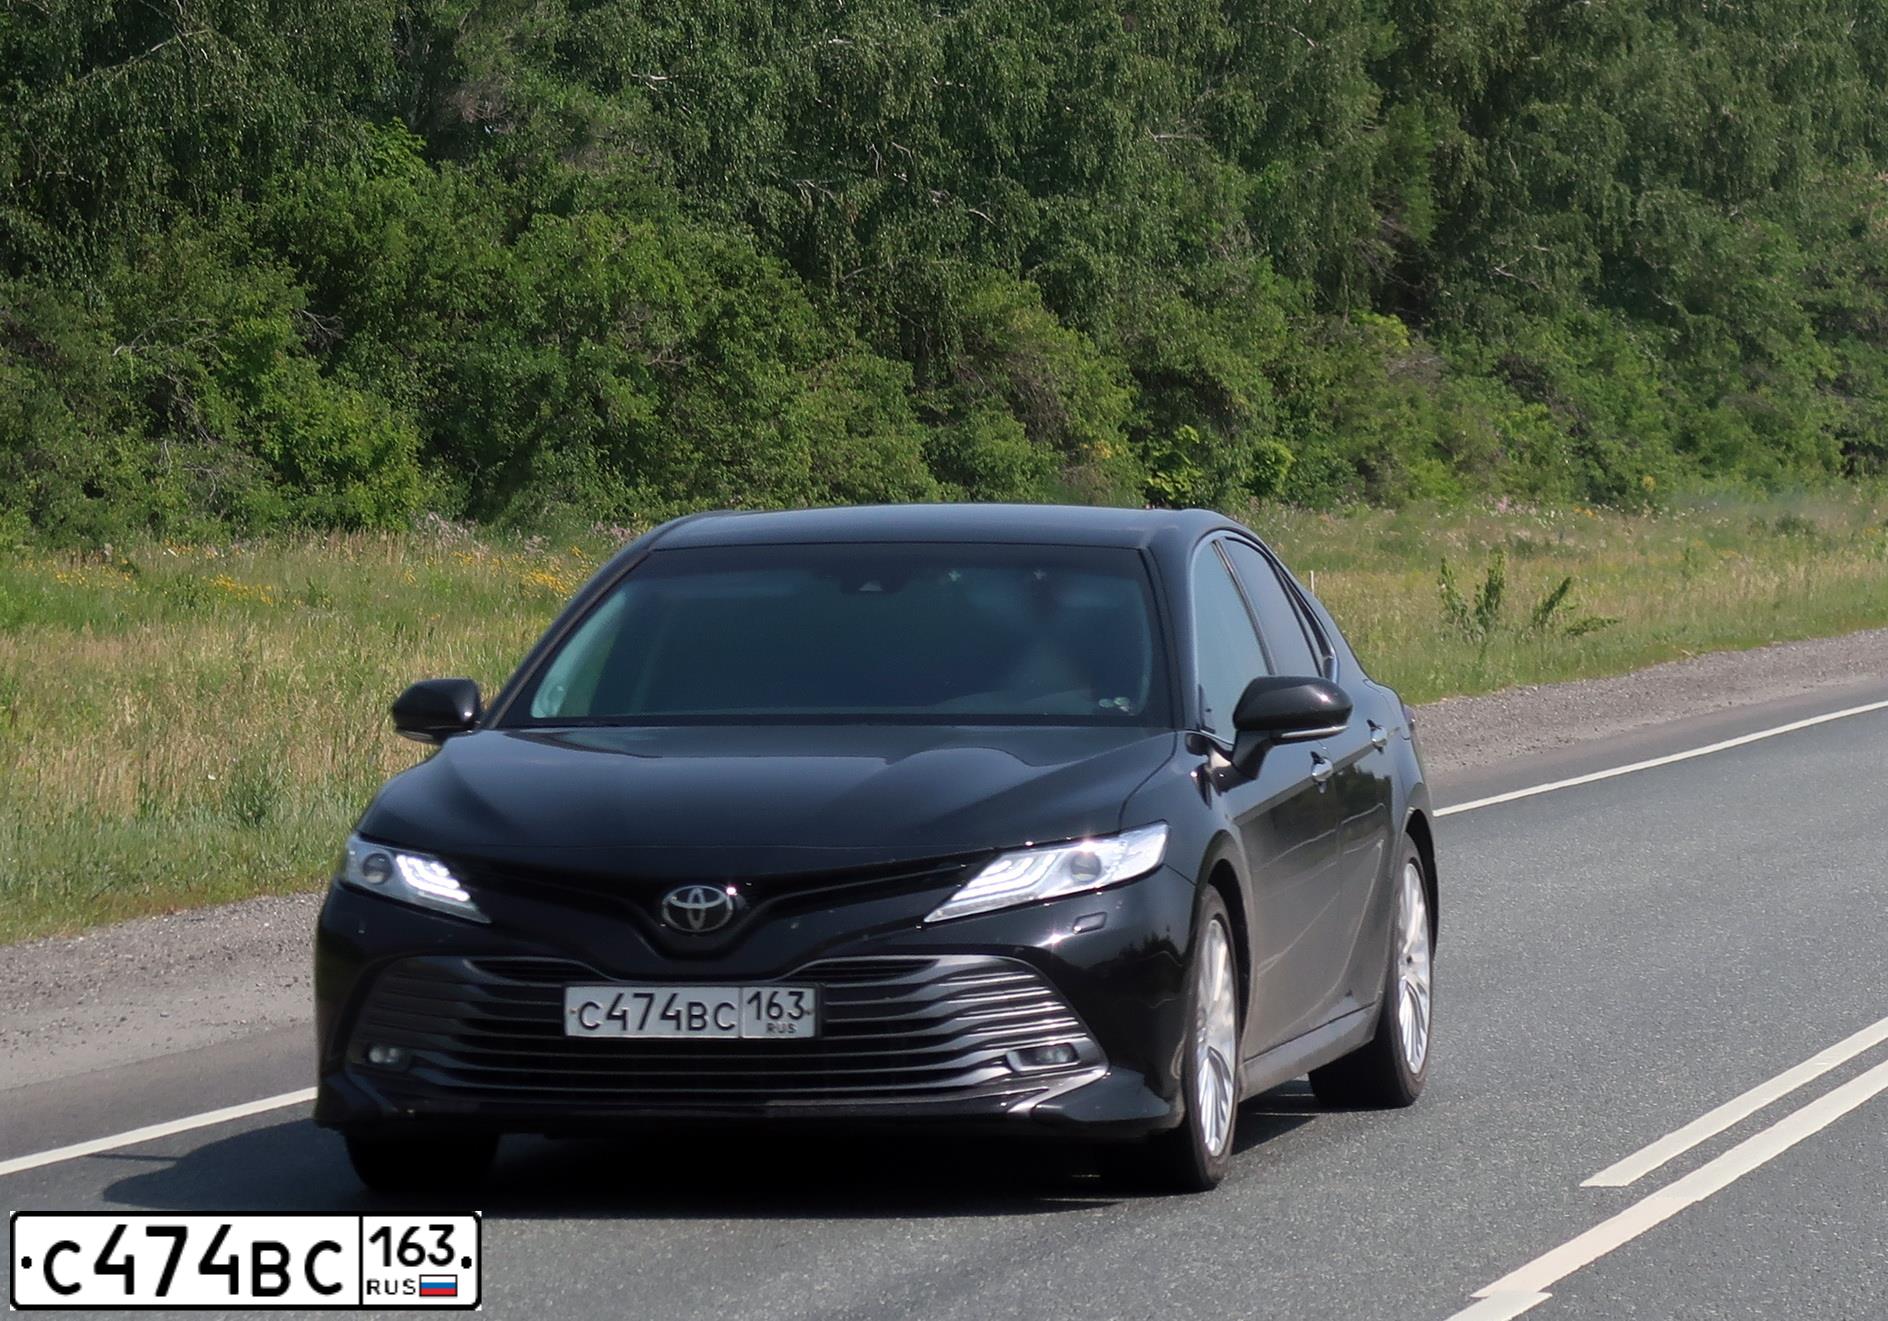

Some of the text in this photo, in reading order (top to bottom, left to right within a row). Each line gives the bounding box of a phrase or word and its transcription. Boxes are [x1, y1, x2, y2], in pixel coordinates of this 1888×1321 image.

[578, 990, 804, 1032] C474BC 163
[766, 1022, 798, 1035] RUS
